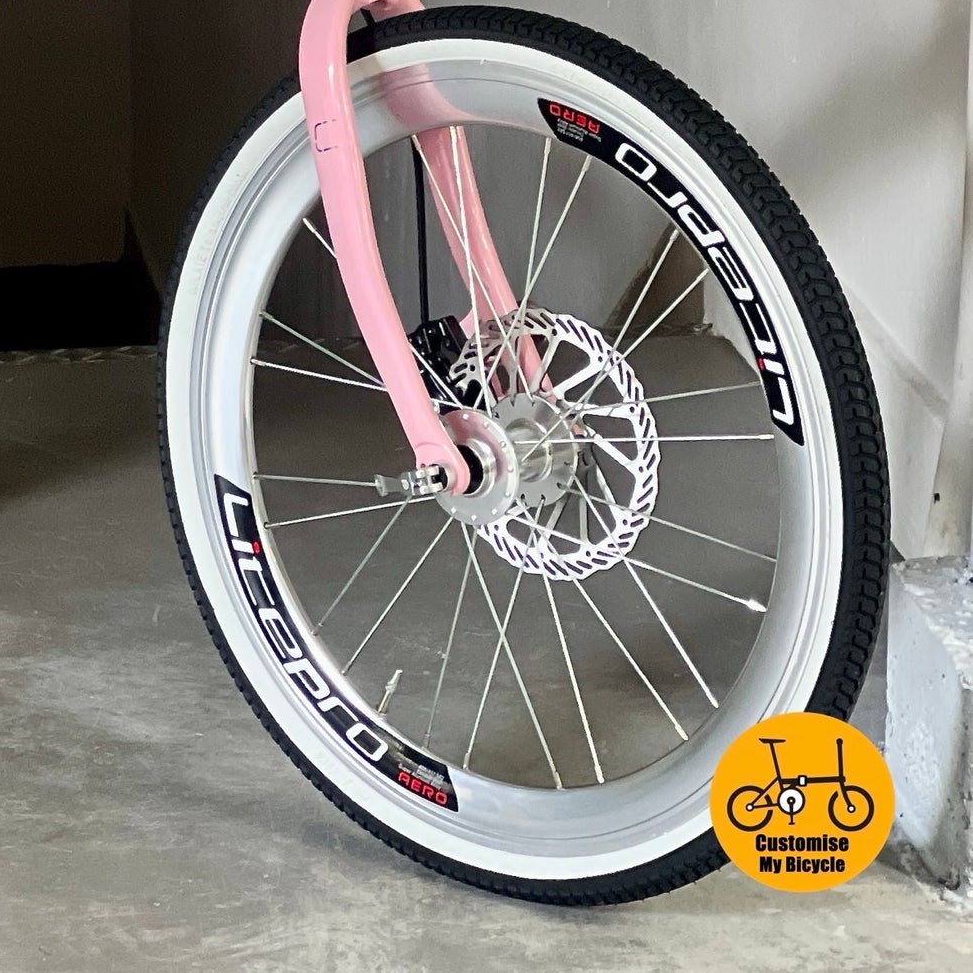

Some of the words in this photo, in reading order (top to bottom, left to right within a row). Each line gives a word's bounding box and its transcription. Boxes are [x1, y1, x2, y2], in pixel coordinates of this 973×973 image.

[549, 103, 600, 134] AERO
[615, 142, 795, 426] Litepro
[222, 492, 389, 762] Litepro
[398, 770, 448, 805] AERO
